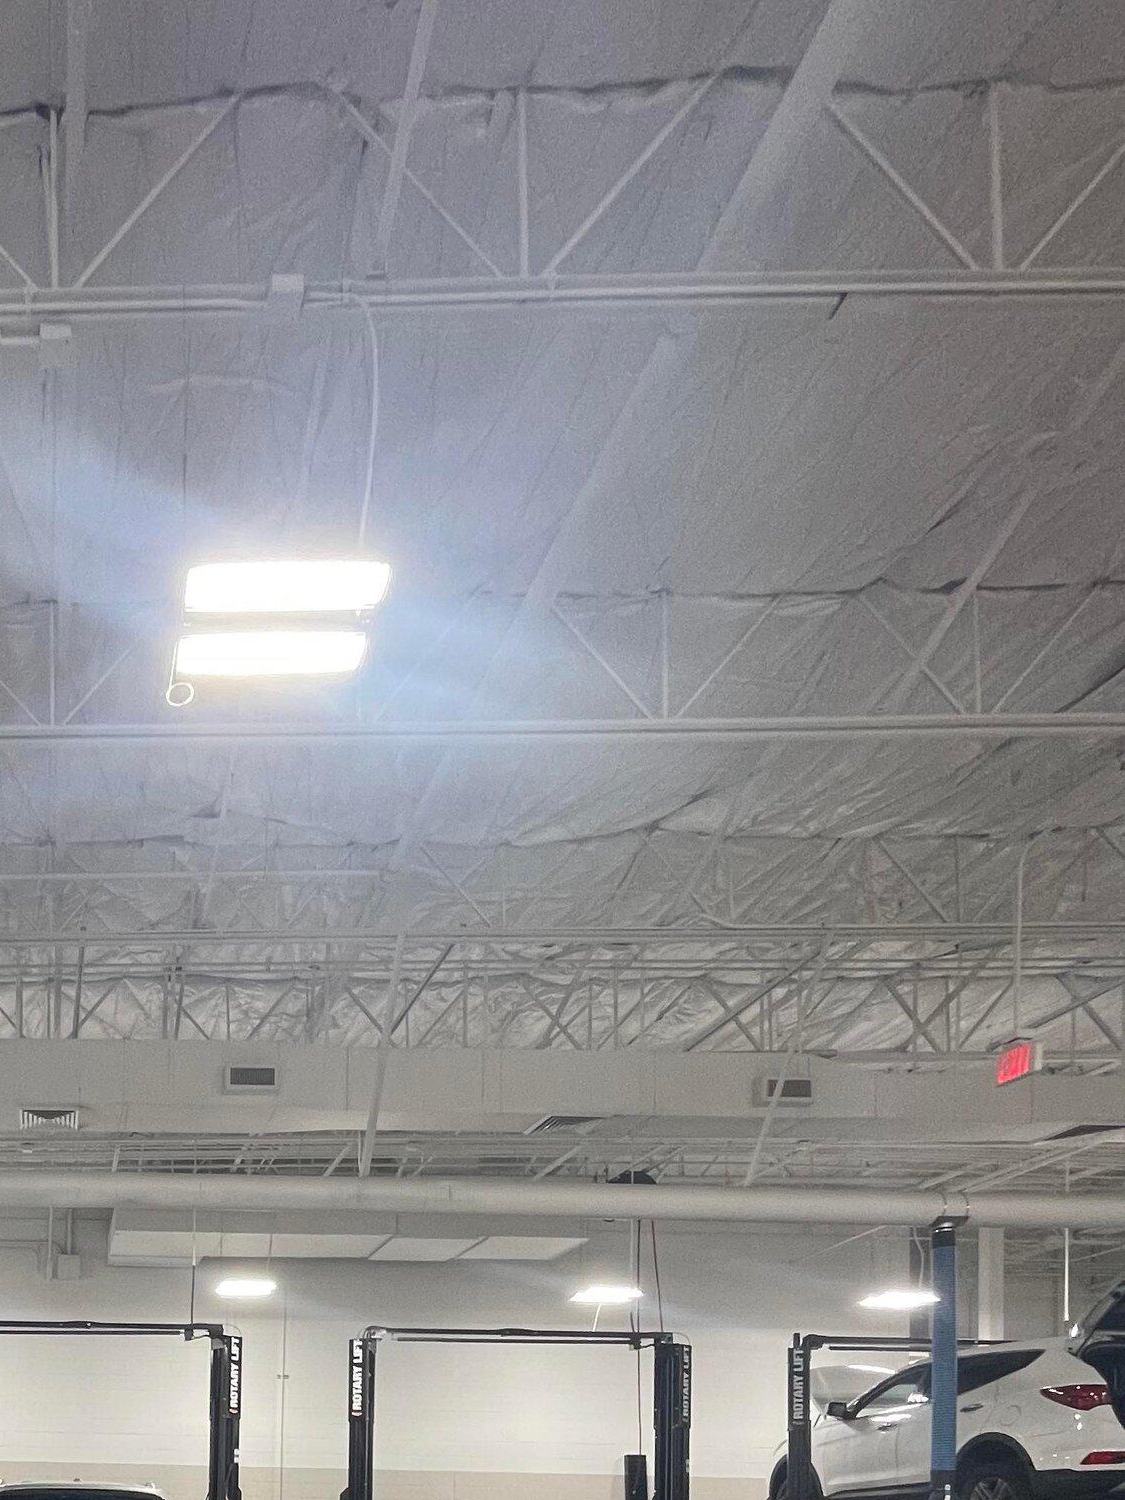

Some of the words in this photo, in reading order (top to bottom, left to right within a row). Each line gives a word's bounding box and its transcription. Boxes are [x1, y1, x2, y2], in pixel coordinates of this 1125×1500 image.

[230, 1336, 240, 1361] LIFT
[352, 1339, 363, 1364] LIFT
[793, 1348, 804, 1372] LIFT
[229, 1362, 239, 1408] ROTARY
[352, 1365, 363, 1411] ROTARY
[682, 1371, 690, 1417] ROTARY
[793, 1375, 804, 1420] ROTARY
